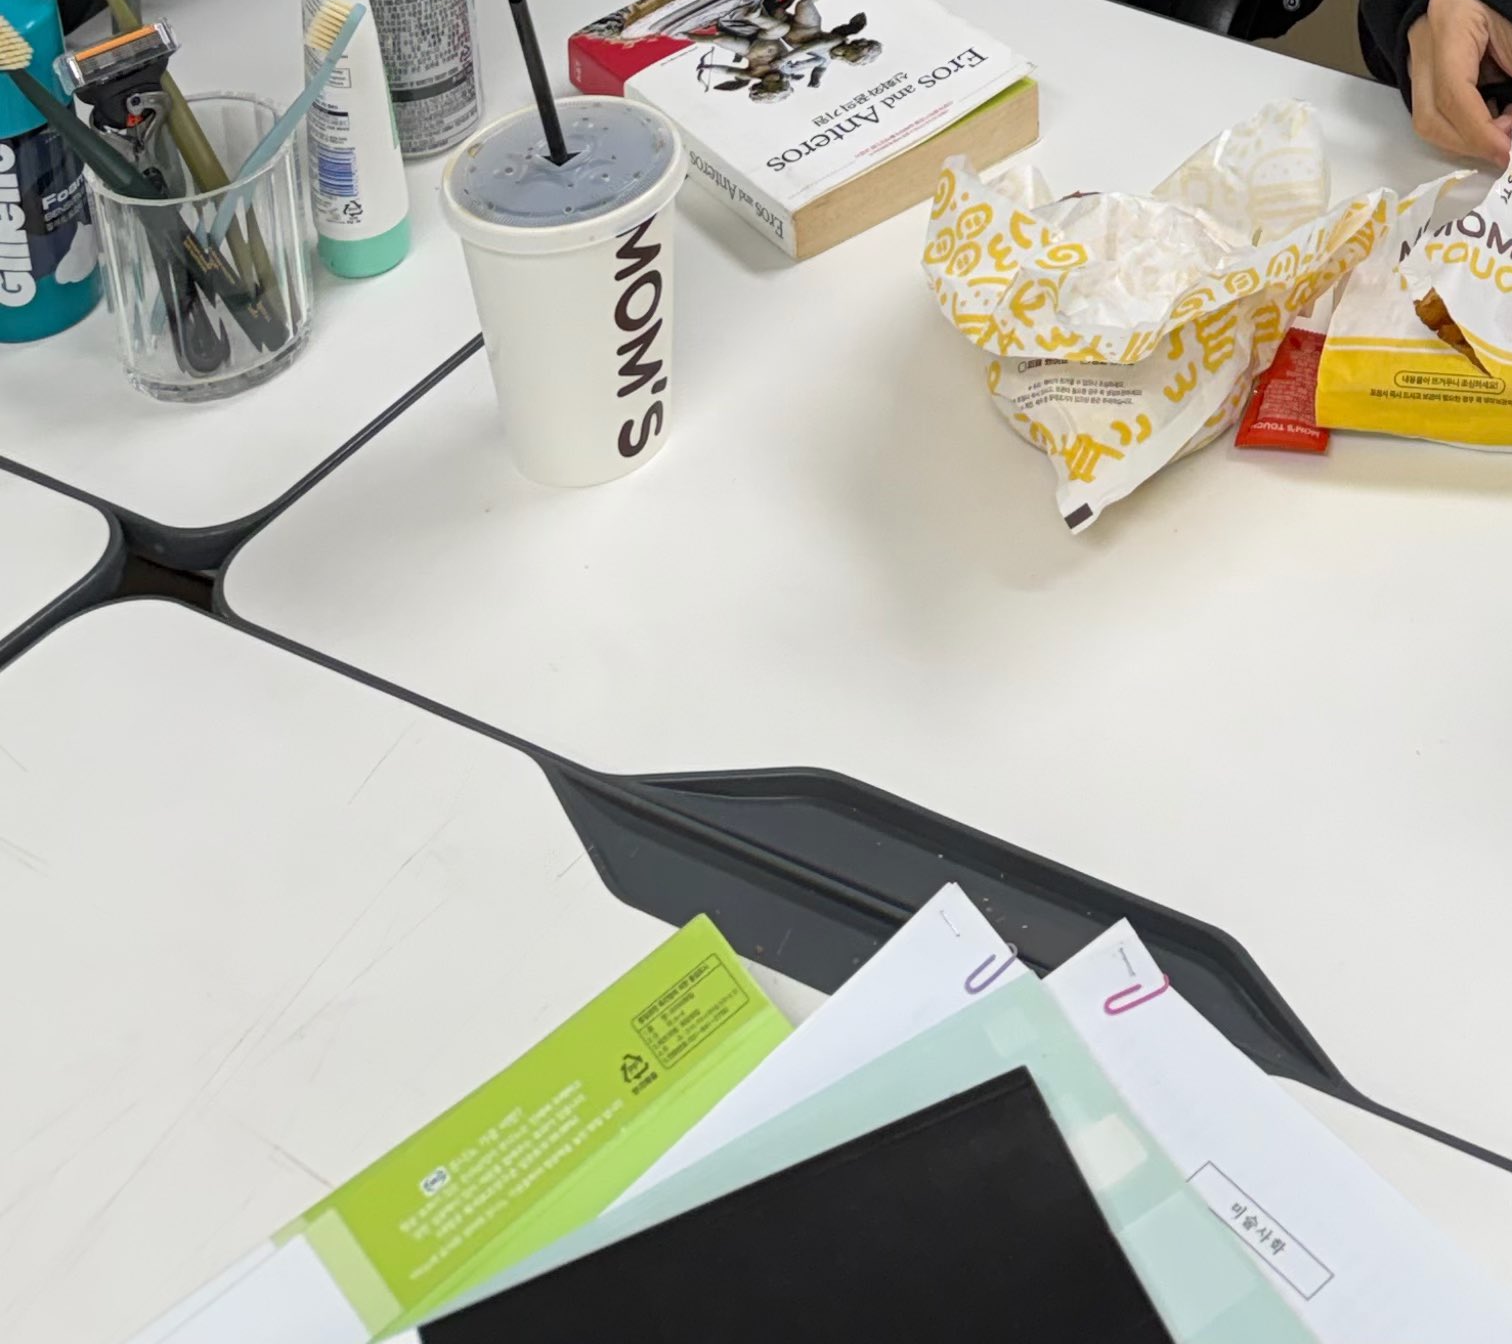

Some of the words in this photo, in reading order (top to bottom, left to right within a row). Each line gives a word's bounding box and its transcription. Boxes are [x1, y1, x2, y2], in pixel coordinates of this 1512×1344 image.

[919, 47, 989, 90] Eros
[883, 84, 916, 110] and
[766, 107, 880, 173] Anteros
[689, 150, 737, 201] Anteros
[755, 201, 784, 240] Eros
[612, 213, 669, 459] MOM'S
